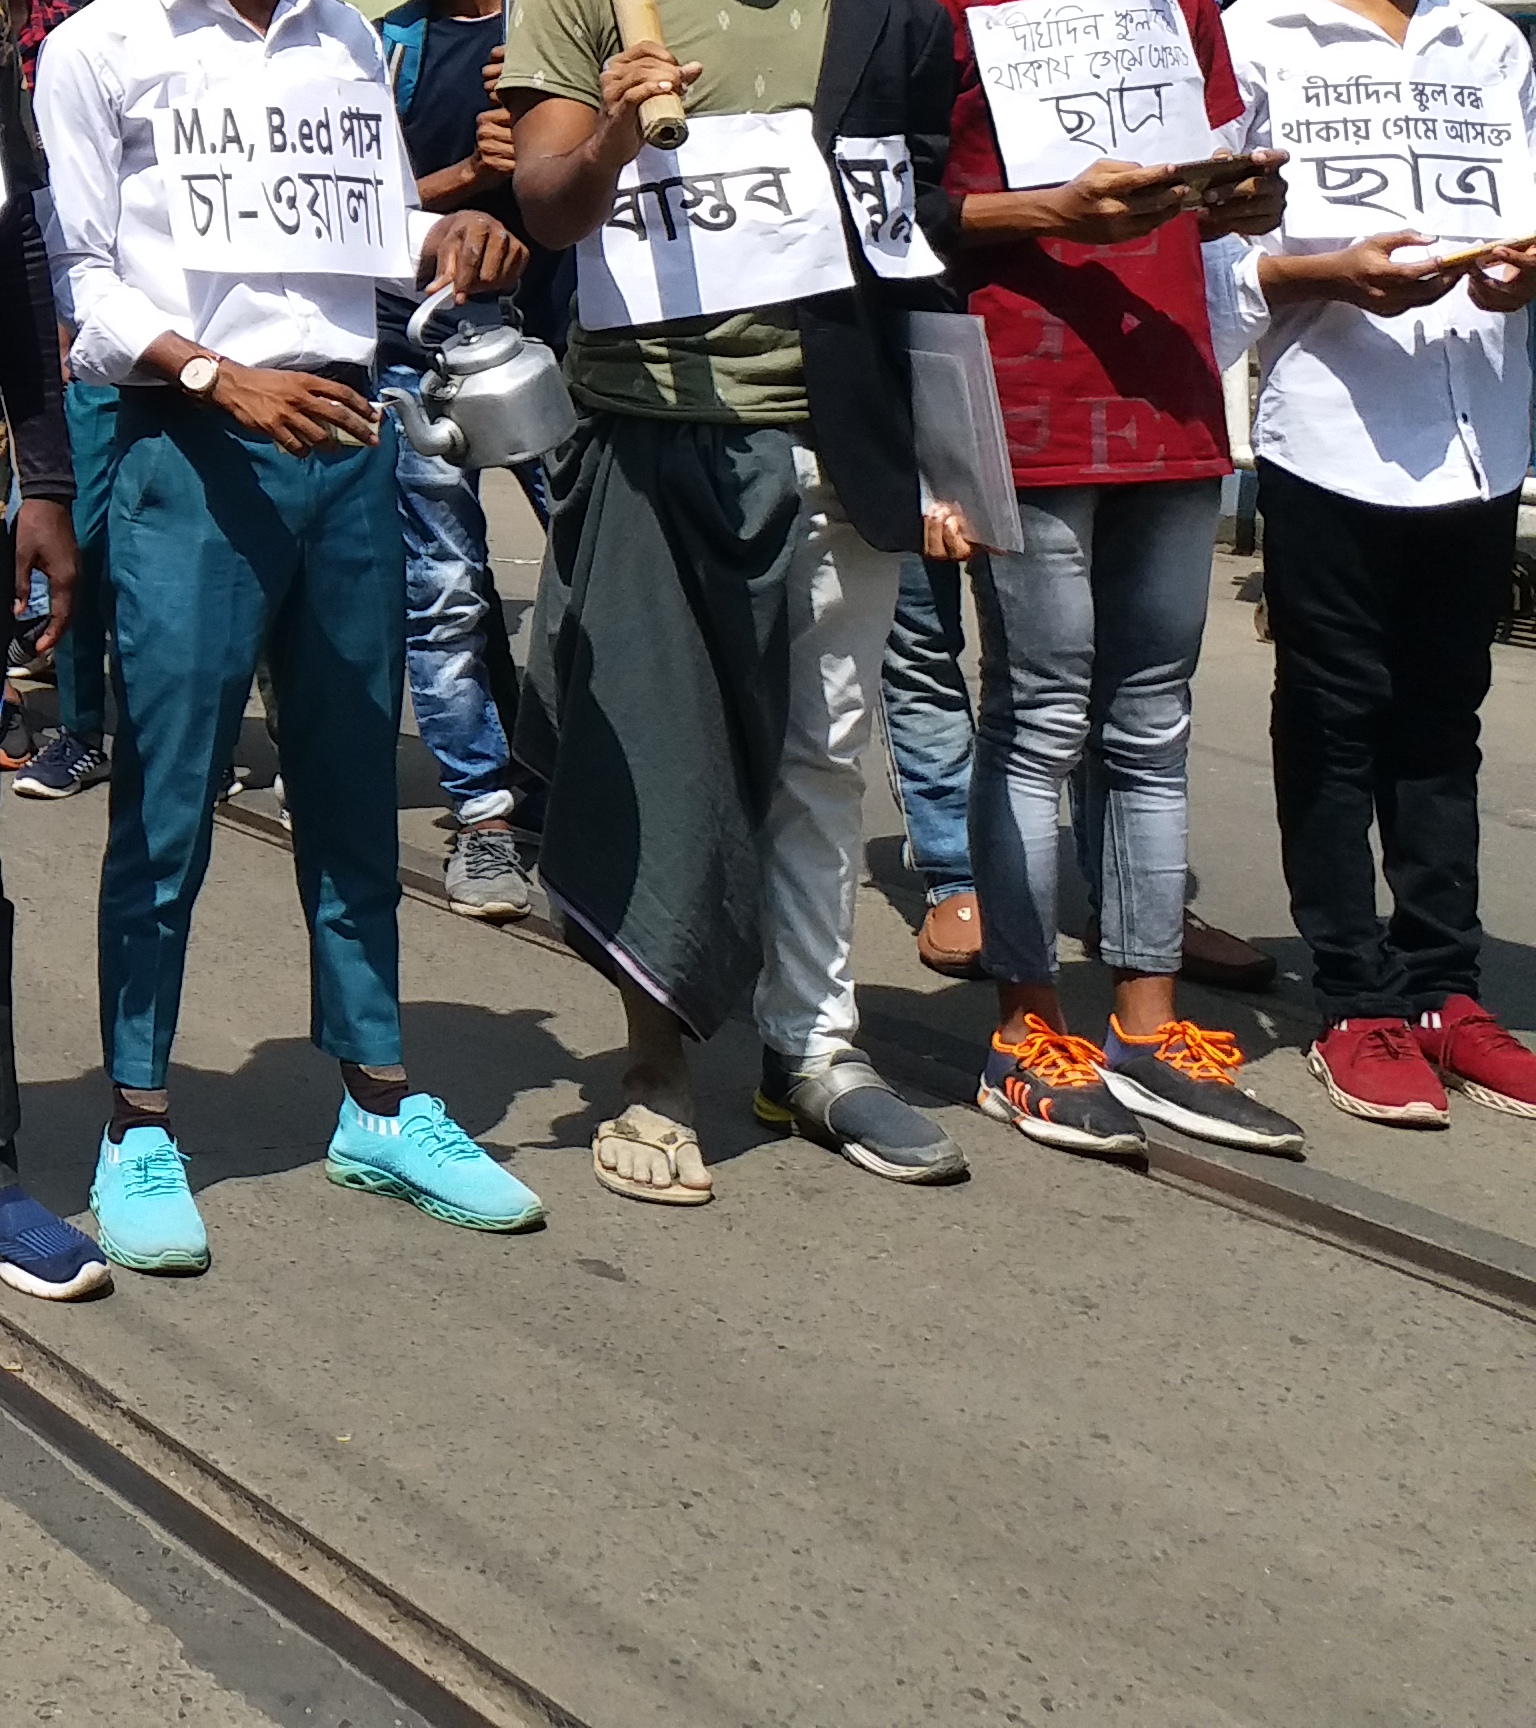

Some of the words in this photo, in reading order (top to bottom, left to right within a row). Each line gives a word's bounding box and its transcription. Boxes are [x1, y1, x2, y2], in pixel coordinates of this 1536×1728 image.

[1005, 5, 1104, 52] দীর্ঘদিন
[1115, 9, 1150, 41] স্কুল
[1302, 75, 1402, 108] দীর্ঘদিন
[1409, 81, 1448, 112] স্কুল
[1451, 85, 1484, 109] বন্ধ
[172, 107, 255, 162] M.A,
[265, 106, 333, 155] B.ed
[339, 106, 383, 160] পাস
[1281, 117, 1372, 146] থাকায়
[1383, 115, 1438, 140] গেমে
[1443, 119, 1512, 147] আসক্ত
[180, 162, 384, 248] চা-ওয়ালা
[606, 166, 792, 242] বাস্তব
[1300, 144, 1503, 220] ছাত্র
